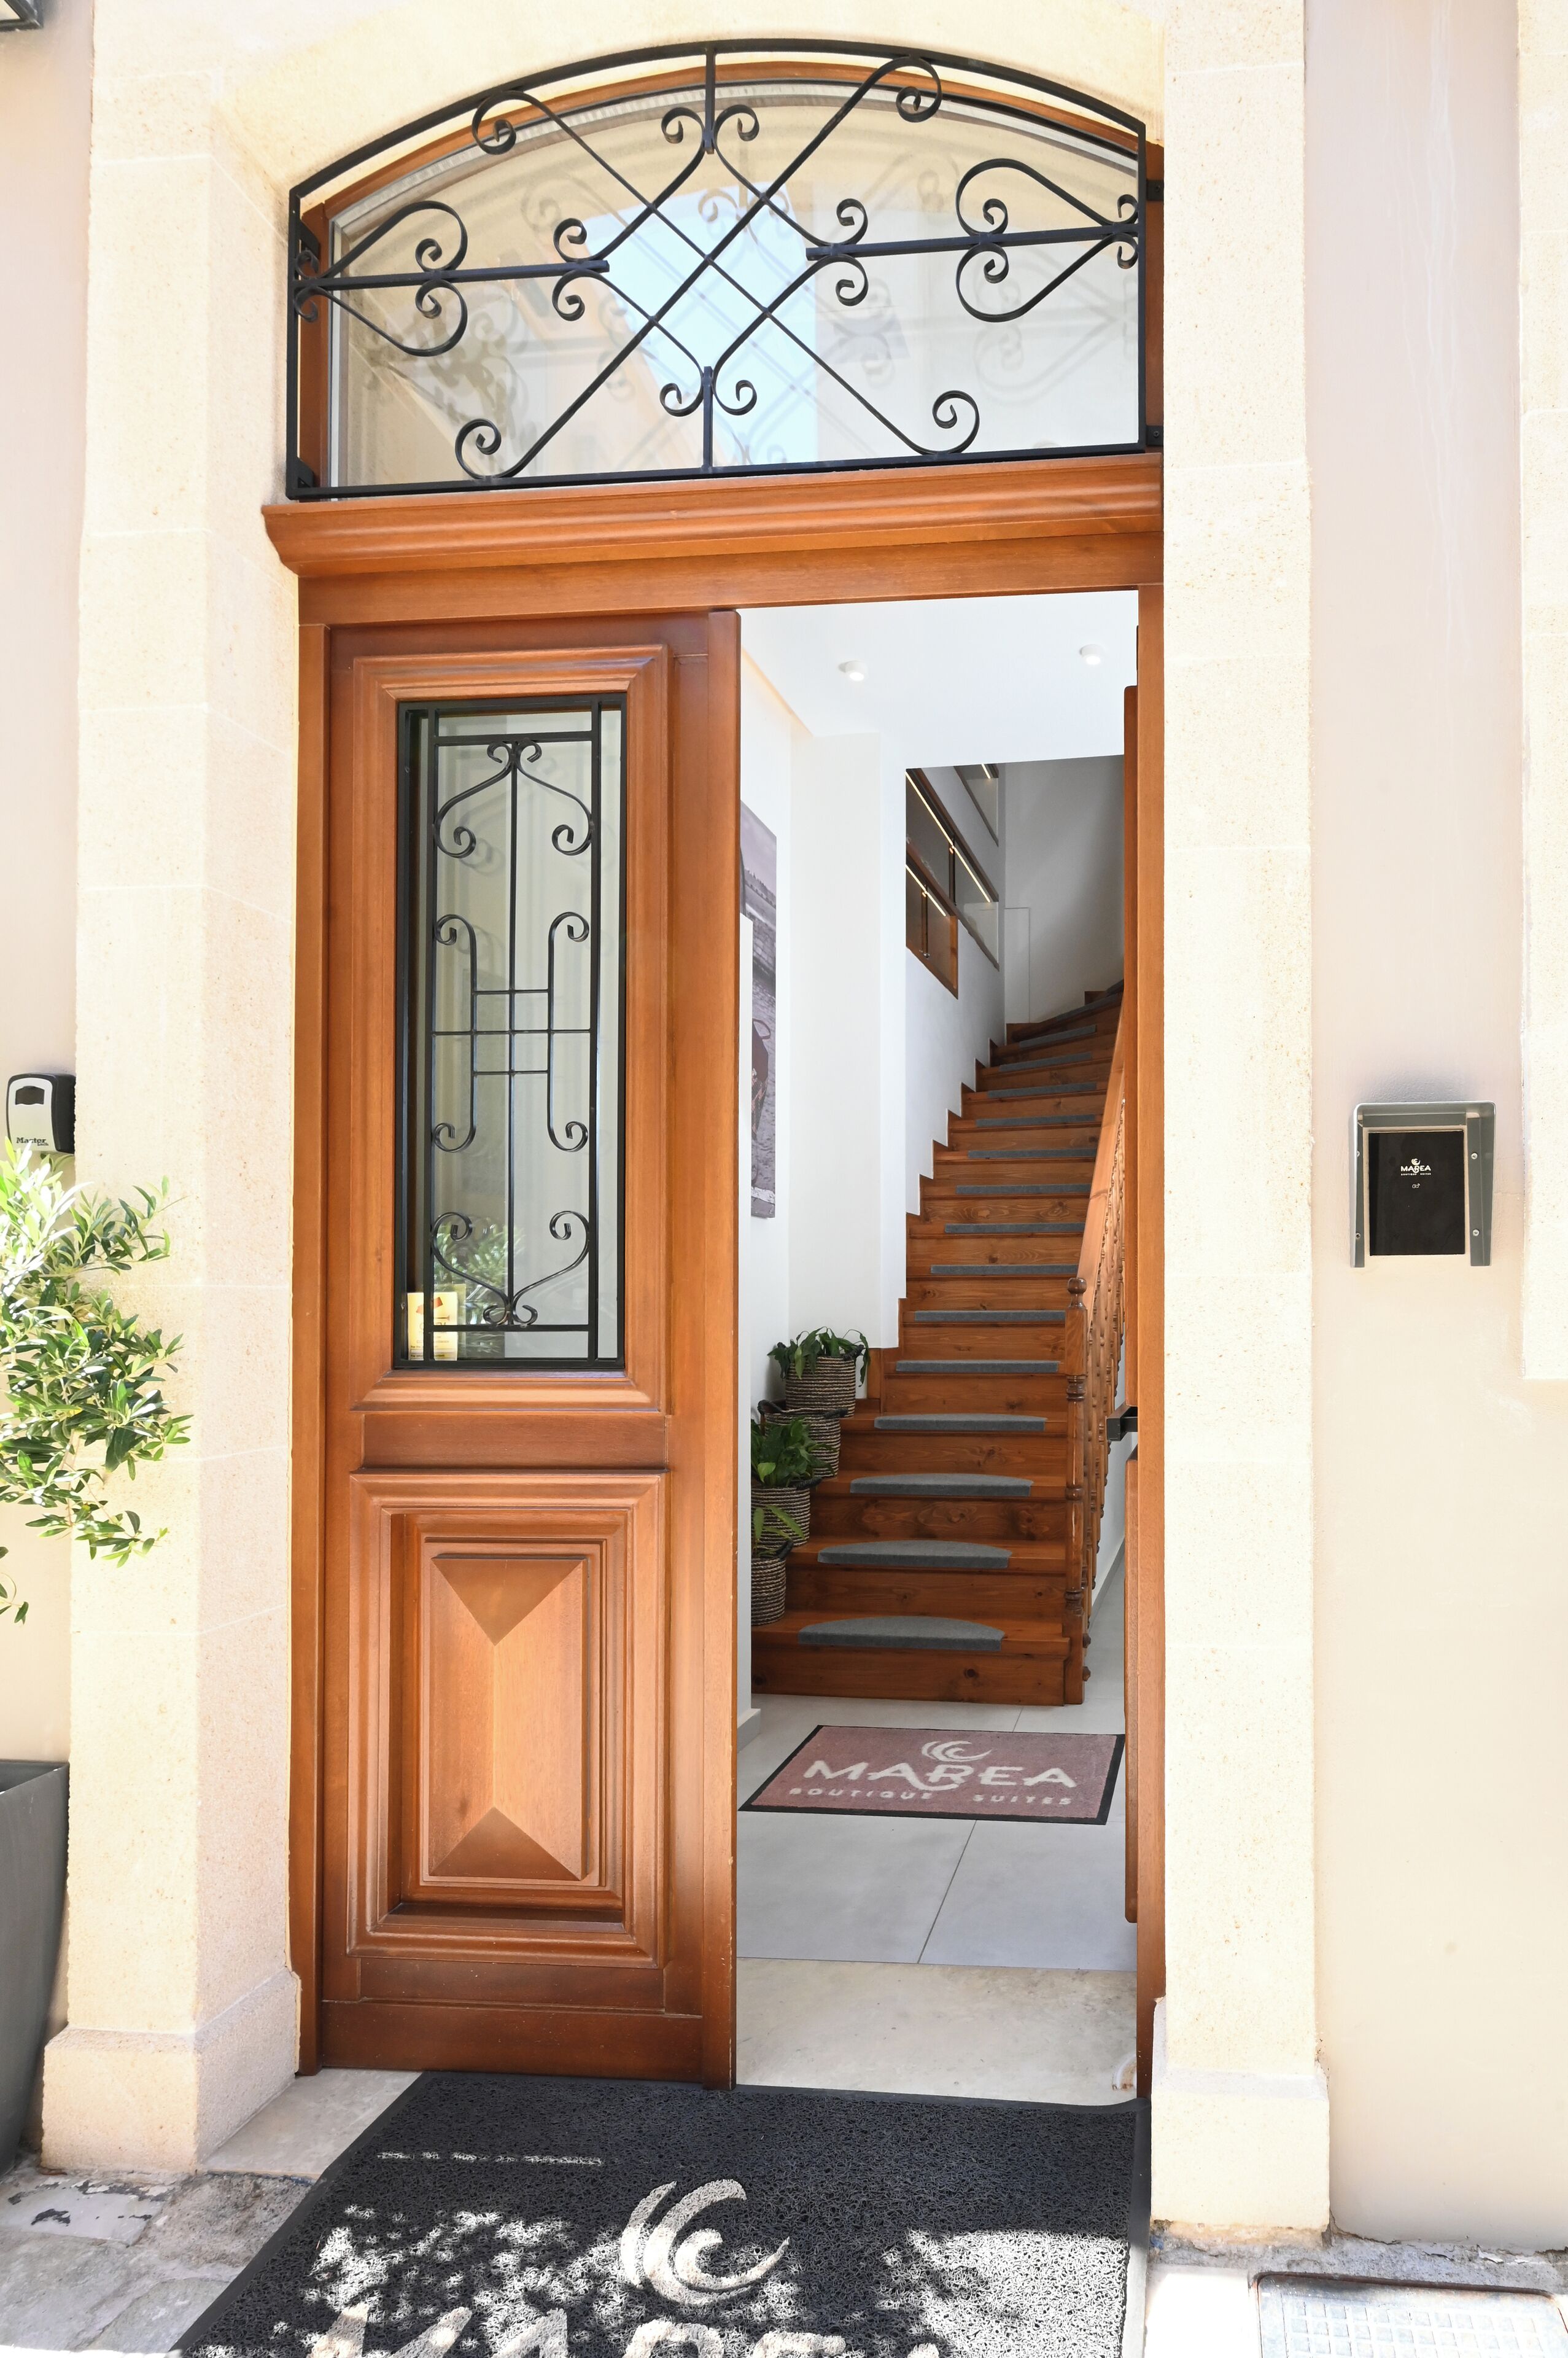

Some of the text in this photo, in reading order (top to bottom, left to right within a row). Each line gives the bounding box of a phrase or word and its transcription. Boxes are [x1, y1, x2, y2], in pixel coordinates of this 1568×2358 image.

[803, 1760, 1077, 1791] MAREA
[789, 1788, 1072, 1805] BOUTIQUE SUITES
